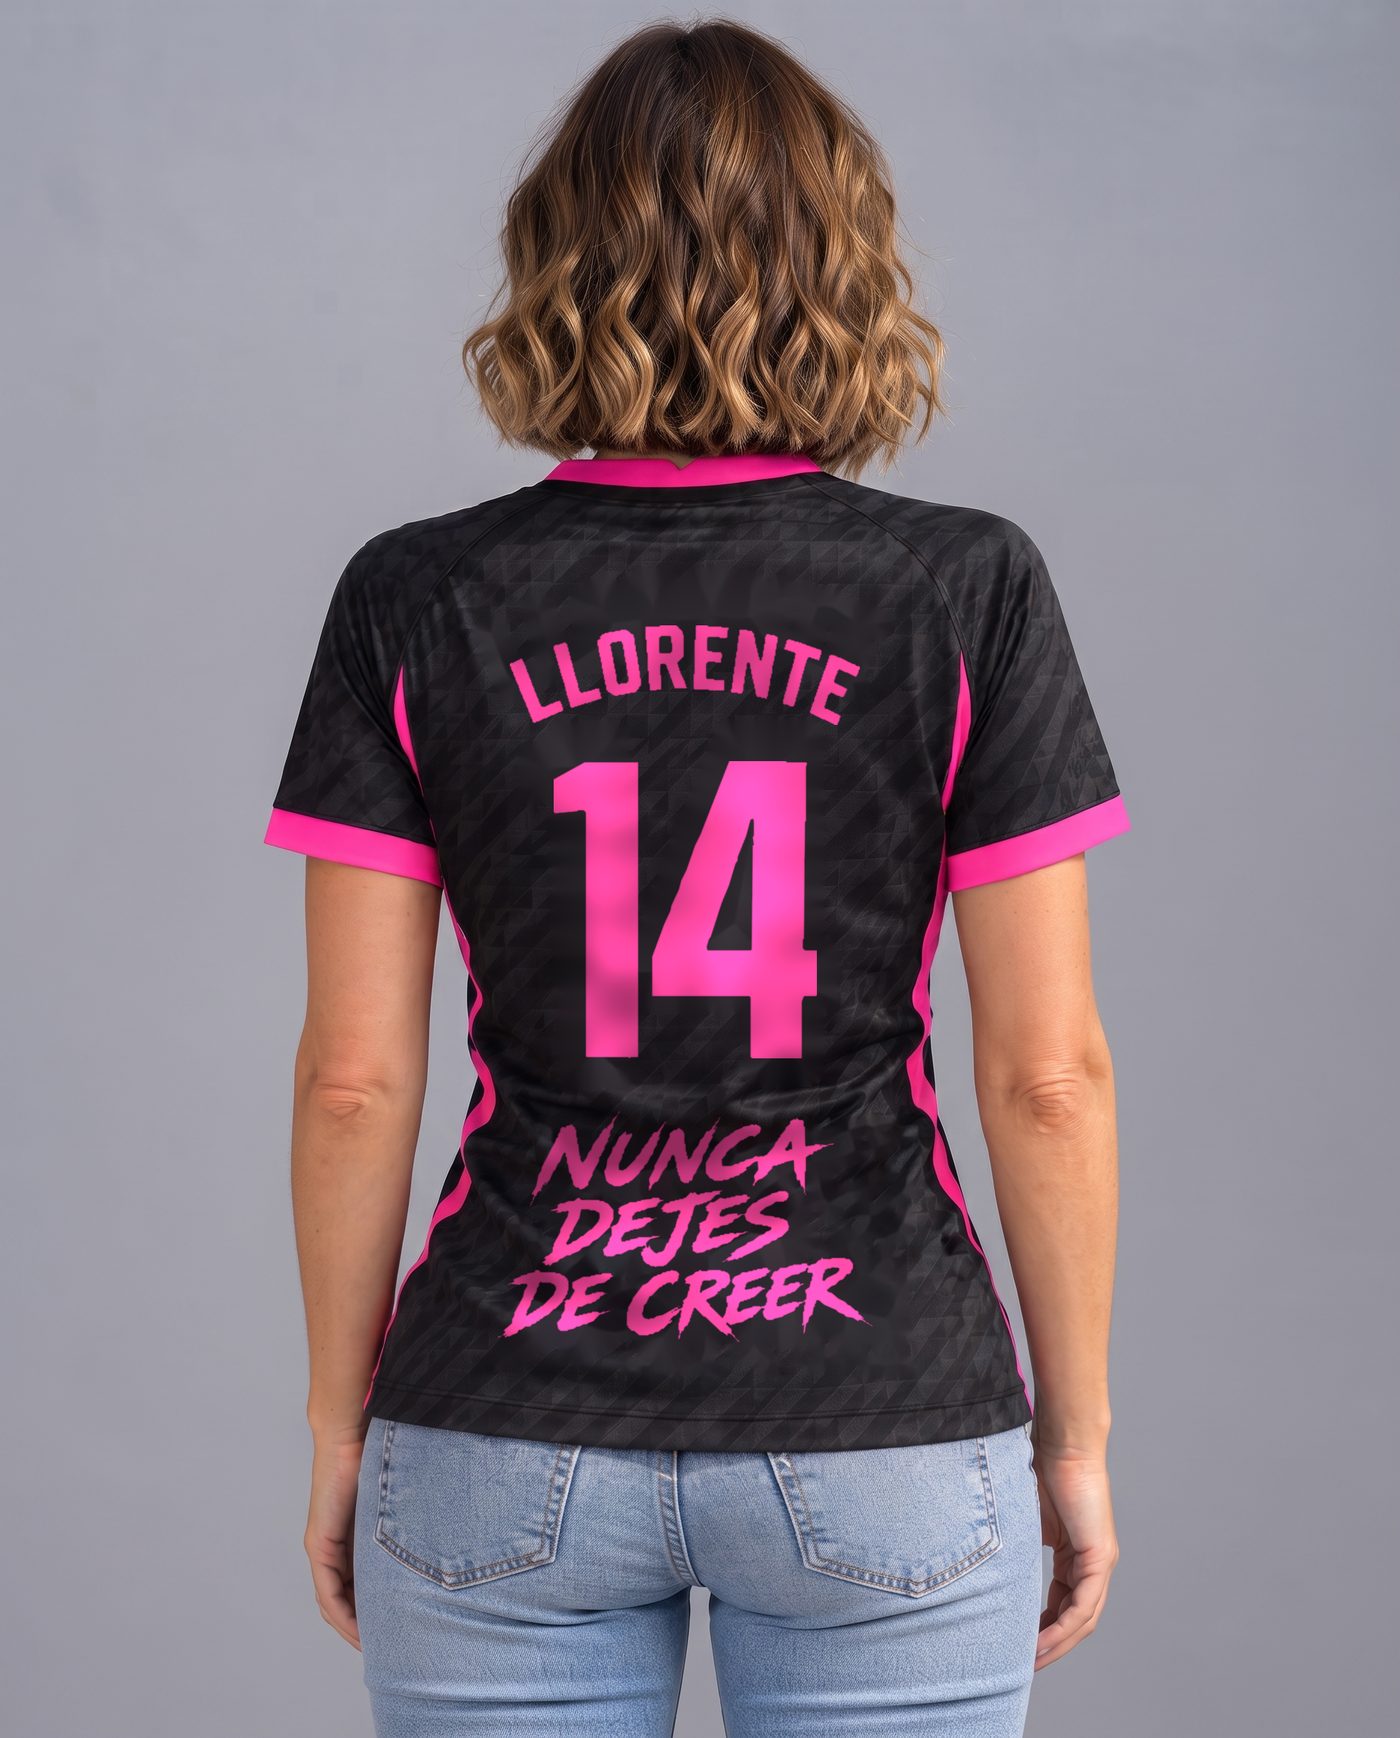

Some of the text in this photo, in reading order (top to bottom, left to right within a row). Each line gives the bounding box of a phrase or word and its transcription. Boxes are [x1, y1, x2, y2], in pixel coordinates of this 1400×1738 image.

[510, 625, 861, 725] LLORENTE
[552, 761, 818, 1058] 14
[531, 1114, 834, 1203] NUNCA
[542, 1190, 789, 1267] DEJES
[499, 1257, 872, 1341] DE CREER
